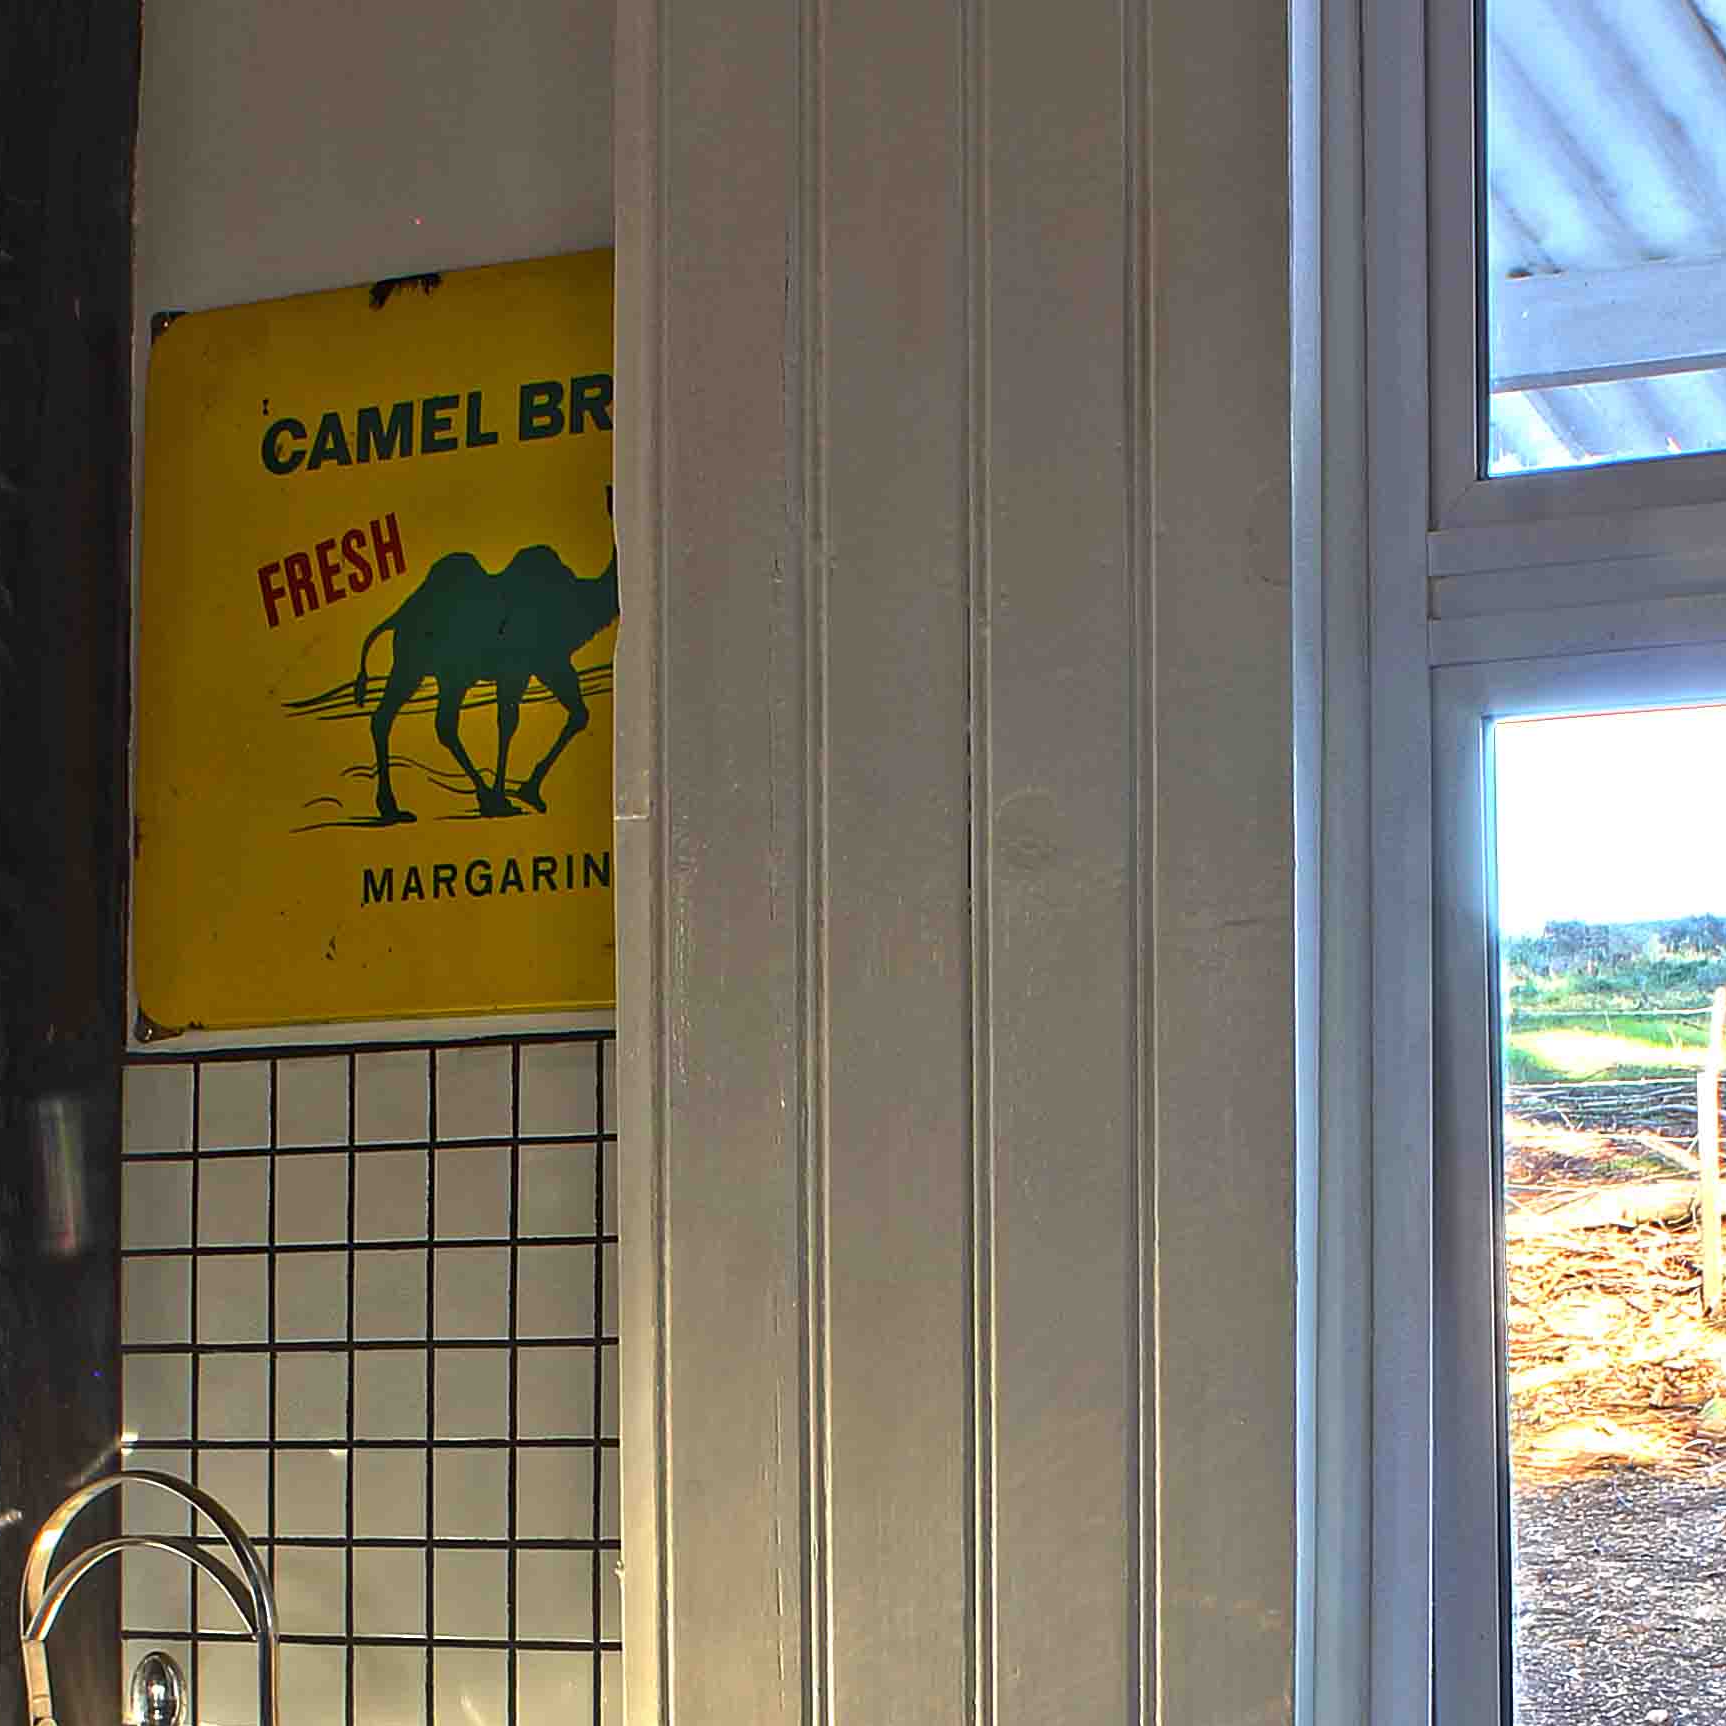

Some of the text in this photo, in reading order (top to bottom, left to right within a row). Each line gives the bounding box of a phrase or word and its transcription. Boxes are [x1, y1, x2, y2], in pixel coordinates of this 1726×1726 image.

[261, 390, 499, 475] CAMEL
[257, 511, 407, 629] FRESH
[362, 851, 611, 905] MARGARIN
